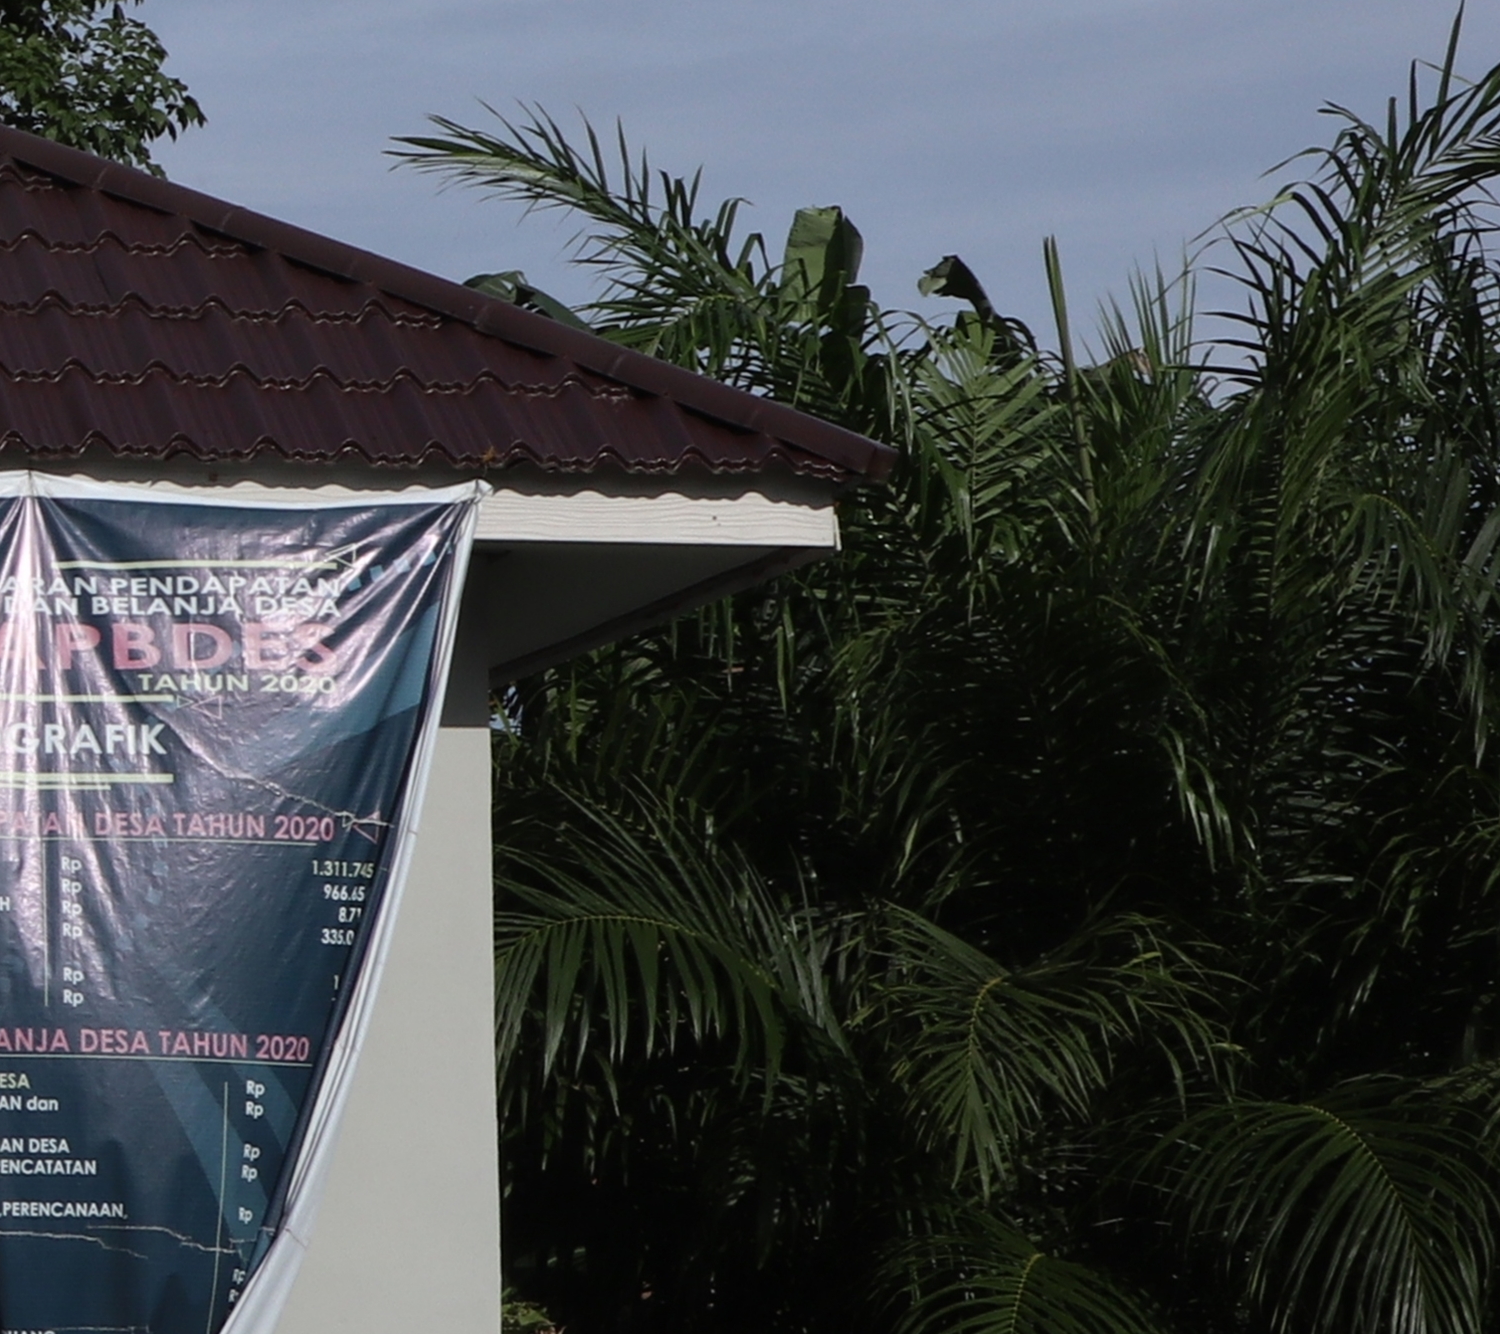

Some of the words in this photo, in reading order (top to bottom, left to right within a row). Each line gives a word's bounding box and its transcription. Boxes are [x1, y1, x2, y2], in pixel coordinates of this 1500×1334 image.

[110, 576, 341, 598] PENDAPATAN
[4, 596, 80, 616] DAN
[92, 596, 242, 617] BELANJA
[254, 597, 342, 618] DESA
[137, 674, 251, 693] TAHUN
[260, 675, 337, 694] 2020
[97, 812, 169, 838] DESA
[173, 813, 266, 839] TAHUN
[274, 815, 336, 843] 2020
[60, 856, 82, 877] Rp
[60, 877, 82, 897] Rp
[61, 898, 83, 919] Rp
[61, 921, 83, 941] Rp
[63, 965, 85, 986] Rp
[63, 988, 85, 1008] Rp
[80, 1029, 150, 1054] DESA
[159, 1031, 248, 1058] TAHUN
[256, 1036, 310, 1061] 2020
[245, 1079, 266, 1099] Rp
[26, 1095, 59, 1112] dan
[245, 1101, 265, 1120] Rp
[28, 1137, 71, 1154] DESA
[243, 1144, 261, 1161] Rp
[241, 1164, 258, 1183] Rp
[238, 1206, 254, 1224] Rp
